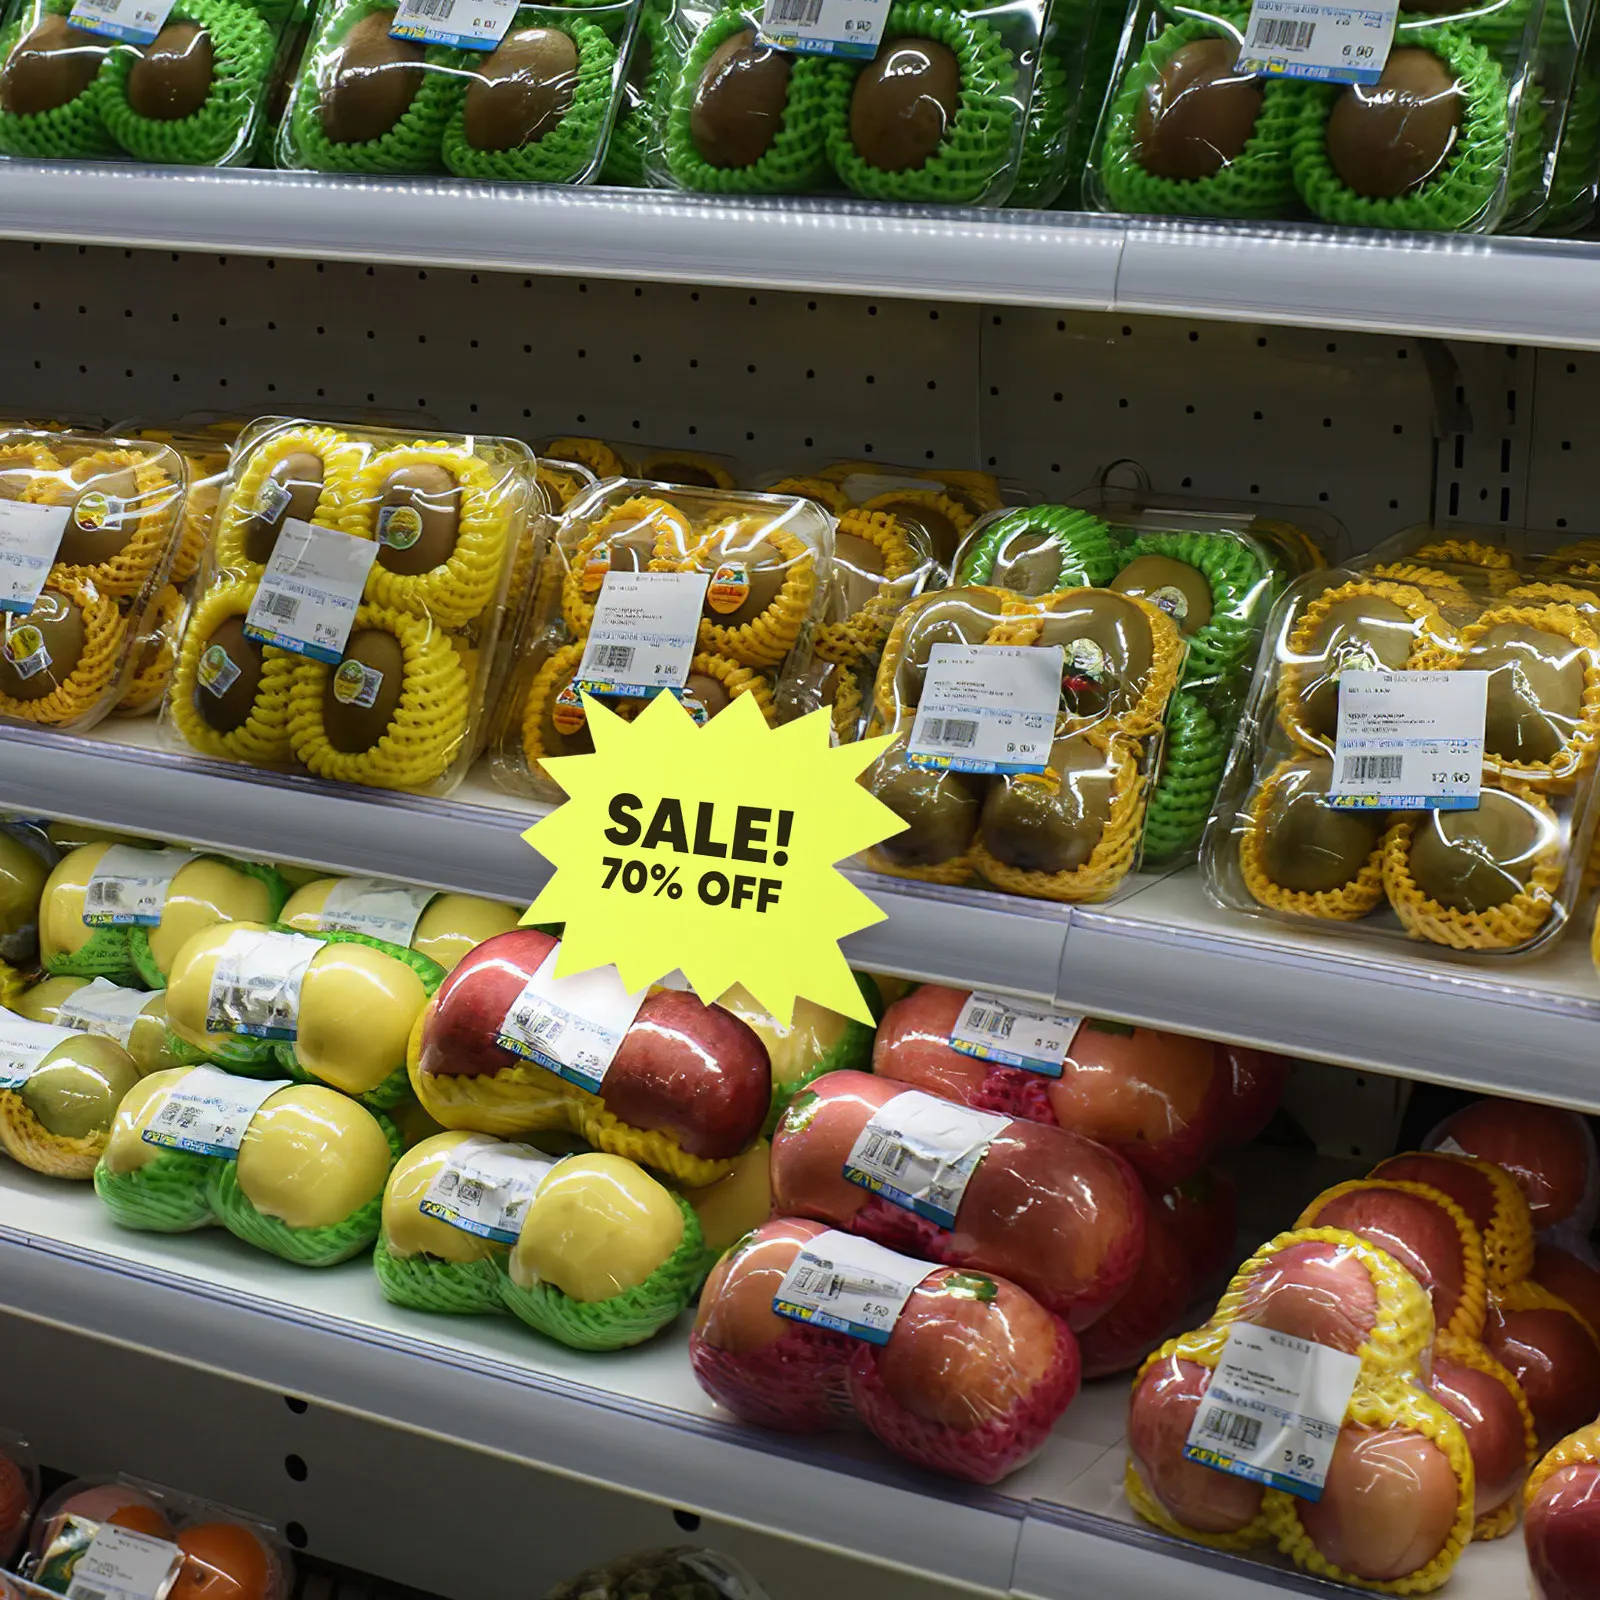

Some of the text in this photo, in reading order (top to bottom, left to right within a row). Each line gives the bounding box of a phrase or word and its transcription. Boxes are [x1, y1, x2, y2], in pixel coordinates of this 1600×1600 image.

[604, 792, 795, 867] SALE!
[600, 856, 783, 914] 70% OFF
